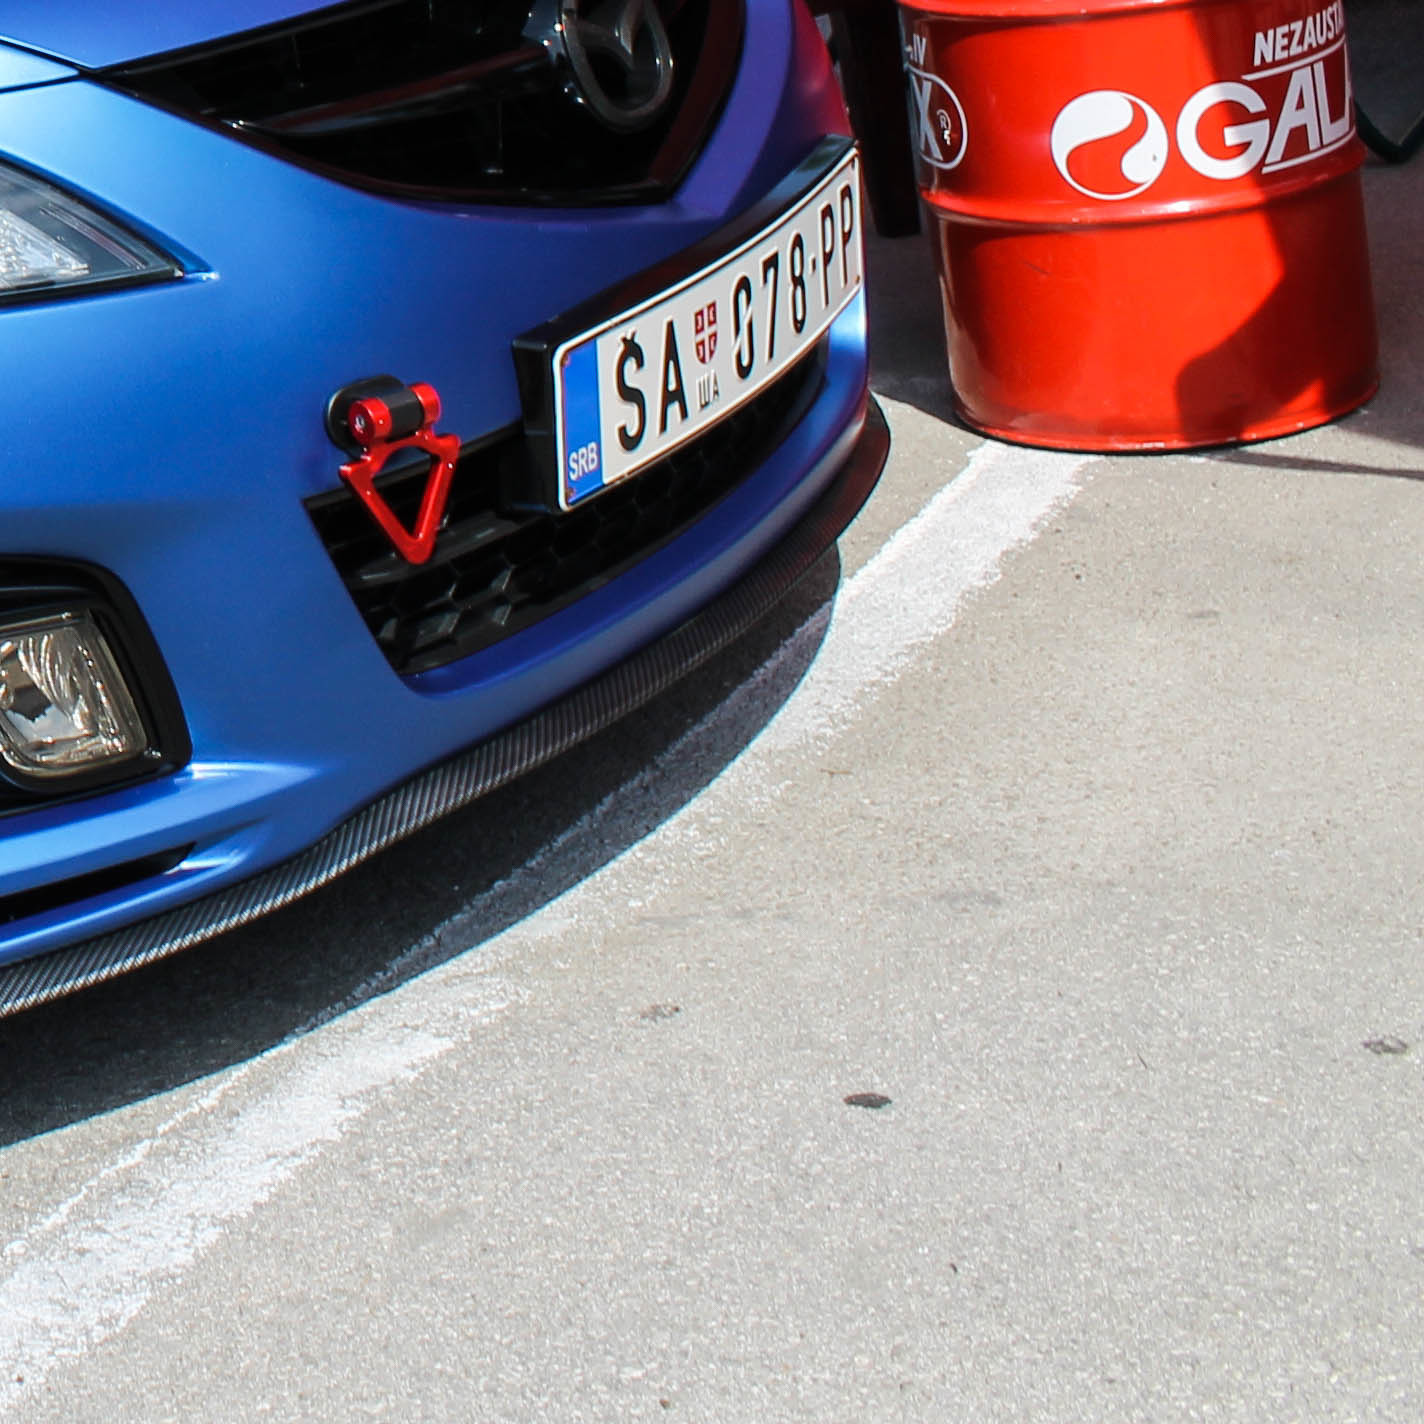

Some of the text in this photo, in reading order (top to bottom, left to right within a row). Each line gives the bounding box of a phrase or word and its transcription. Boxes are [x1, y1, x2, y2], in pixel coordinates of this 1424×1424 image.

[1176, 43, 1351, 180] GAL
[616, 330, 689, 452] ŠA
[569, 441, 599, 481] SRB
